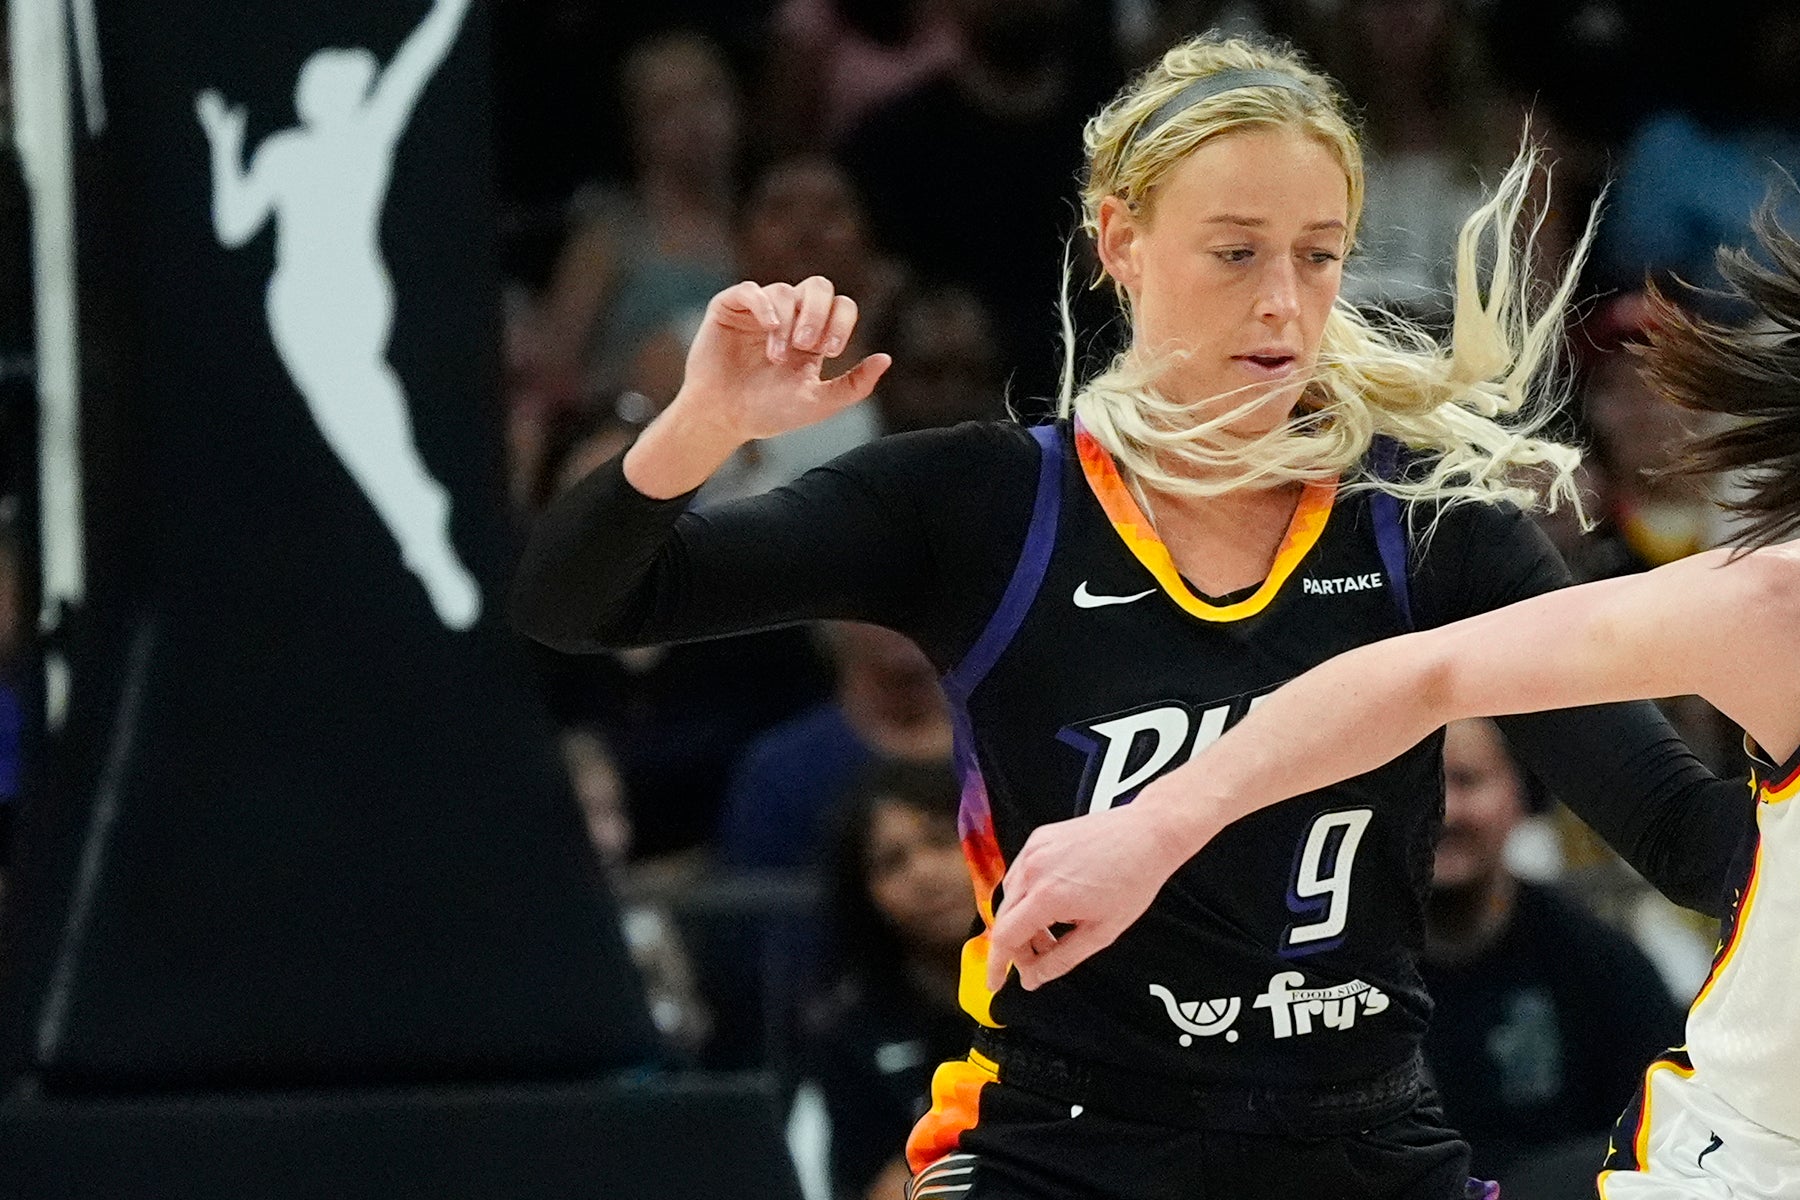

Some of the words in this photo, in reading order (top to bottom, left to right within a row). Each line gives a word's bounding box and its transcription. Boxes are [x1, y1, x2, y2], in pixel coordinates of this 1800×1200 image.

[1302, 572, 1383, 596] PARTAKE
[1289, 809, 1373, 944] 9
[1292, 989, 1332, 1001] FOOD
